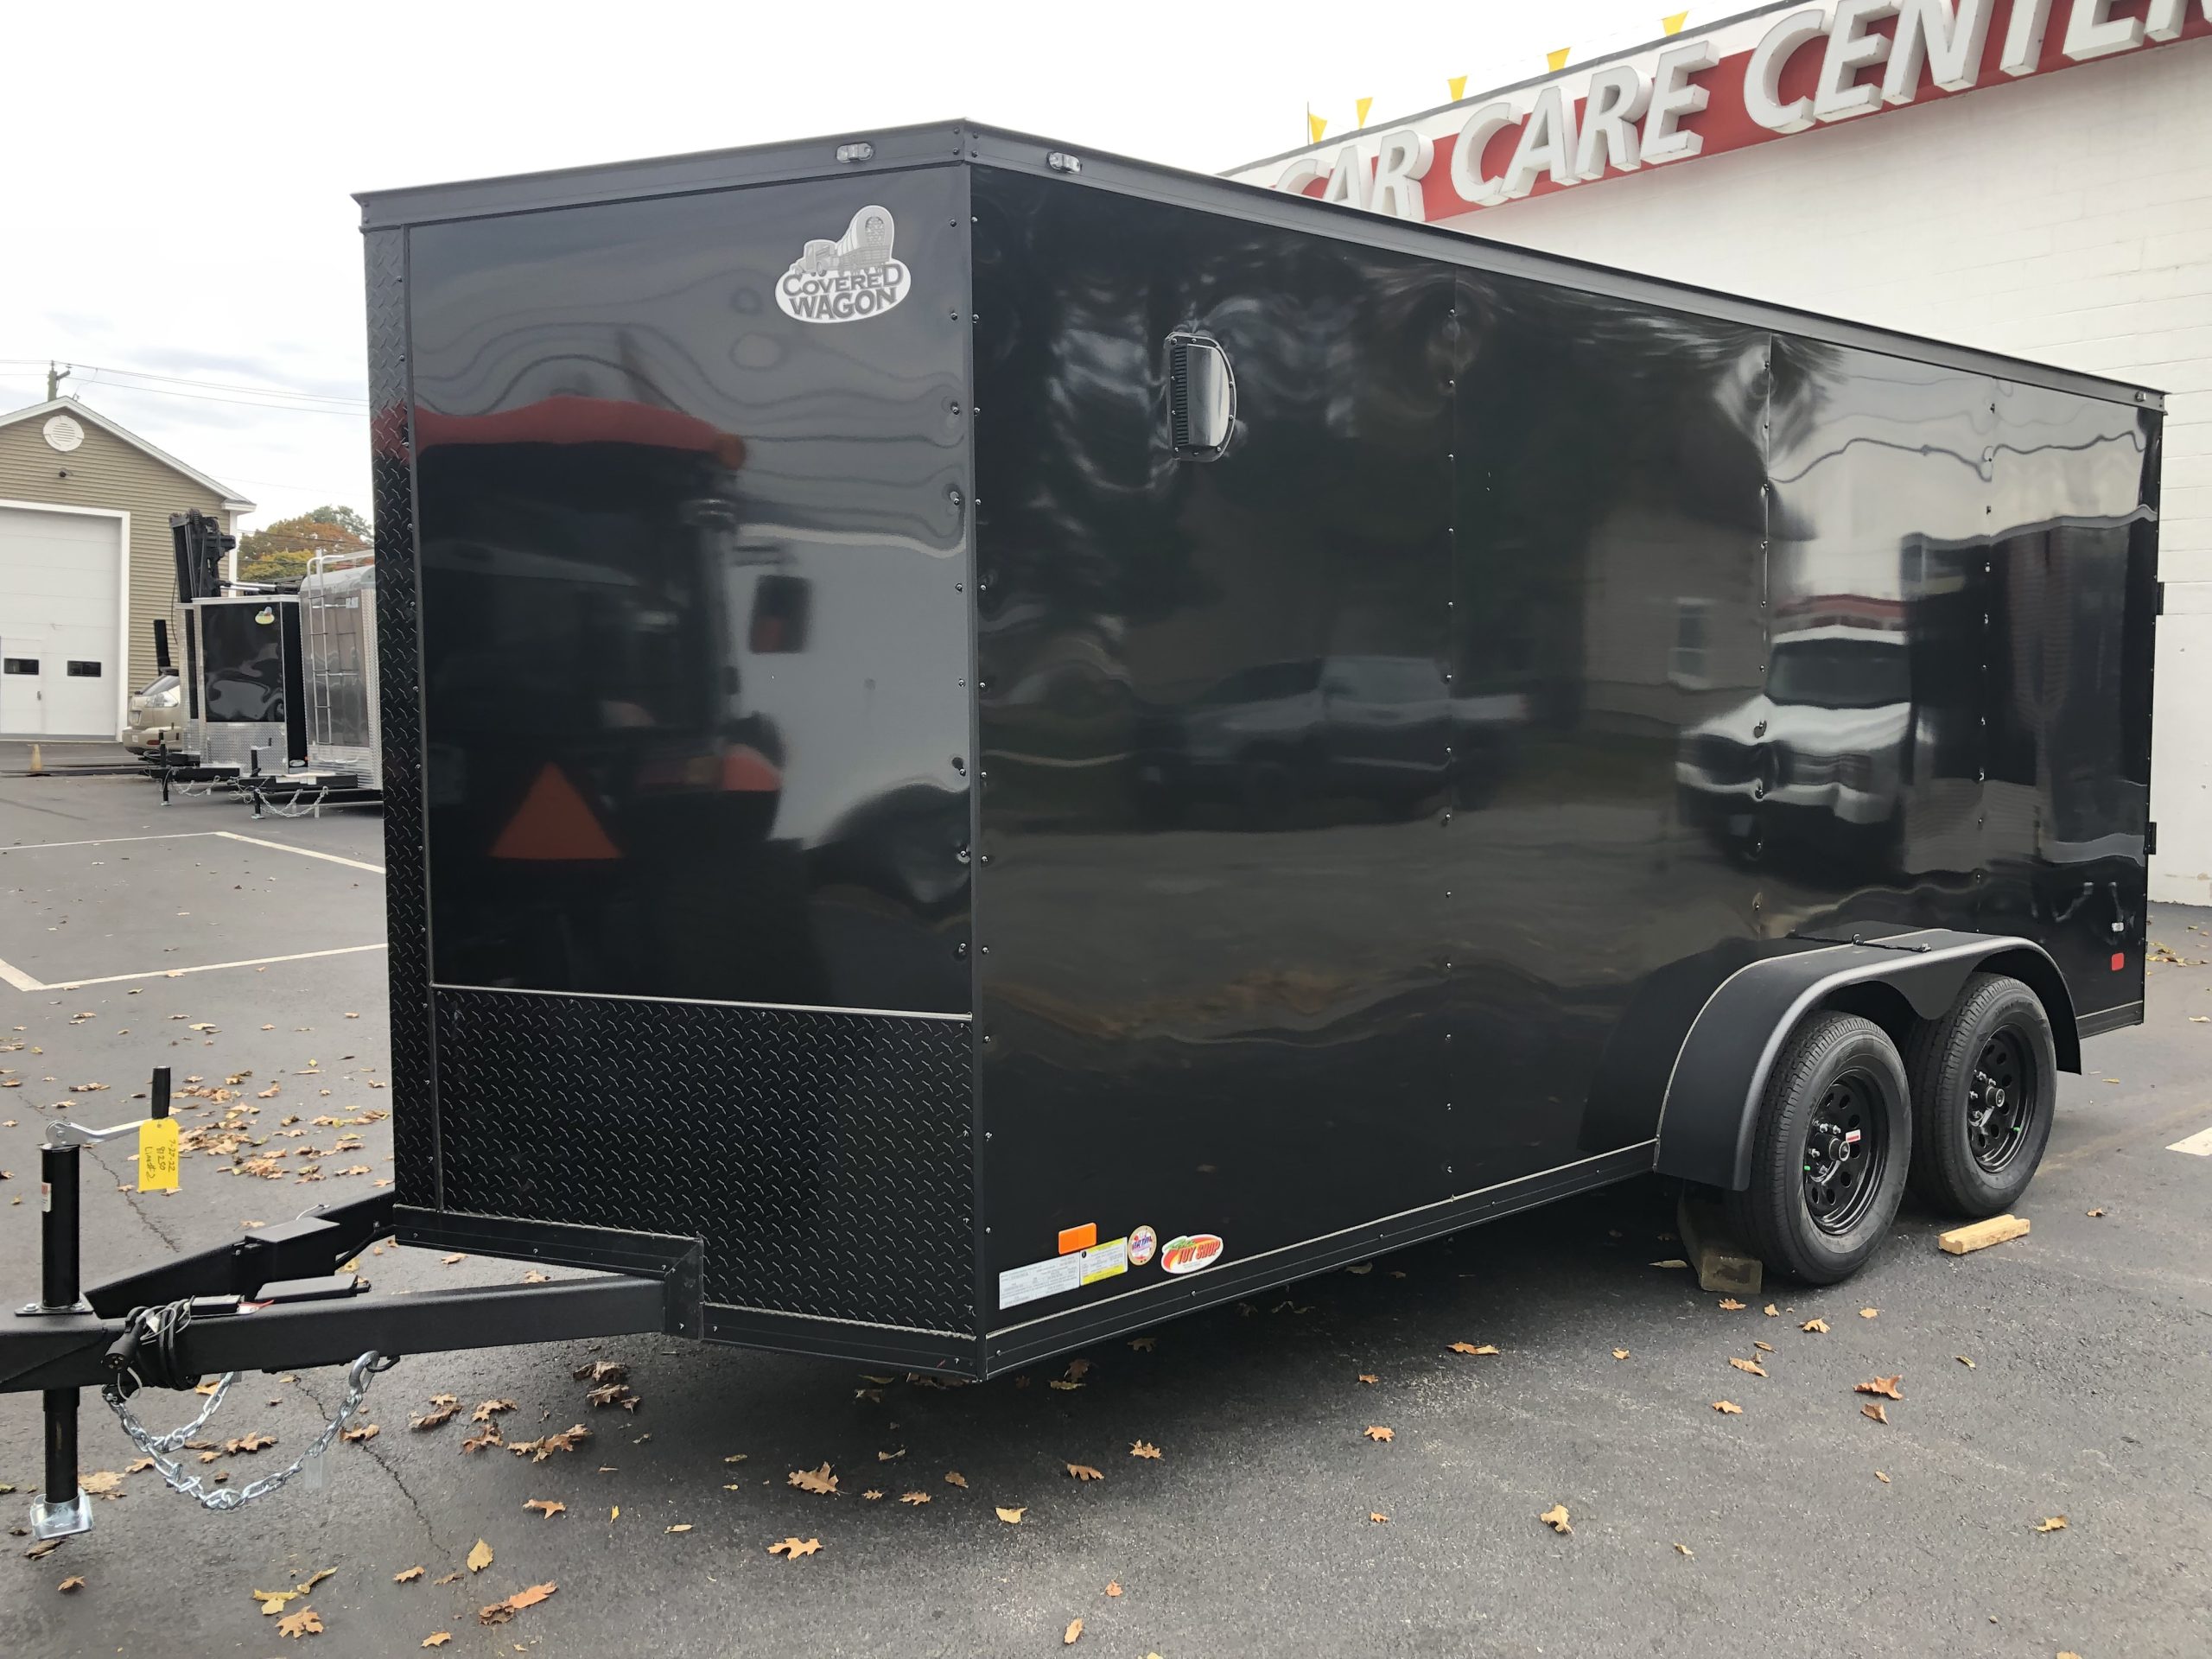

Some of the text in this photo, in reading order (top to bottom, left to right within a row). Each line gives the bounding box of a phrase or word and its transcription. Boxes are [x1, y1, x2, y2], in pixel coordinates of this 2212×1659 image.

[1449, 41, 1719, 207] CARE
[1744, 0, 2212, 134] CEN
[782, 263, 905, 296] COVERED
[788, 286, 897, 321] WAGON
[1177, 1246, 1197, 1264] TOY
[1196, 1240, 1221, 1260] SHOP
